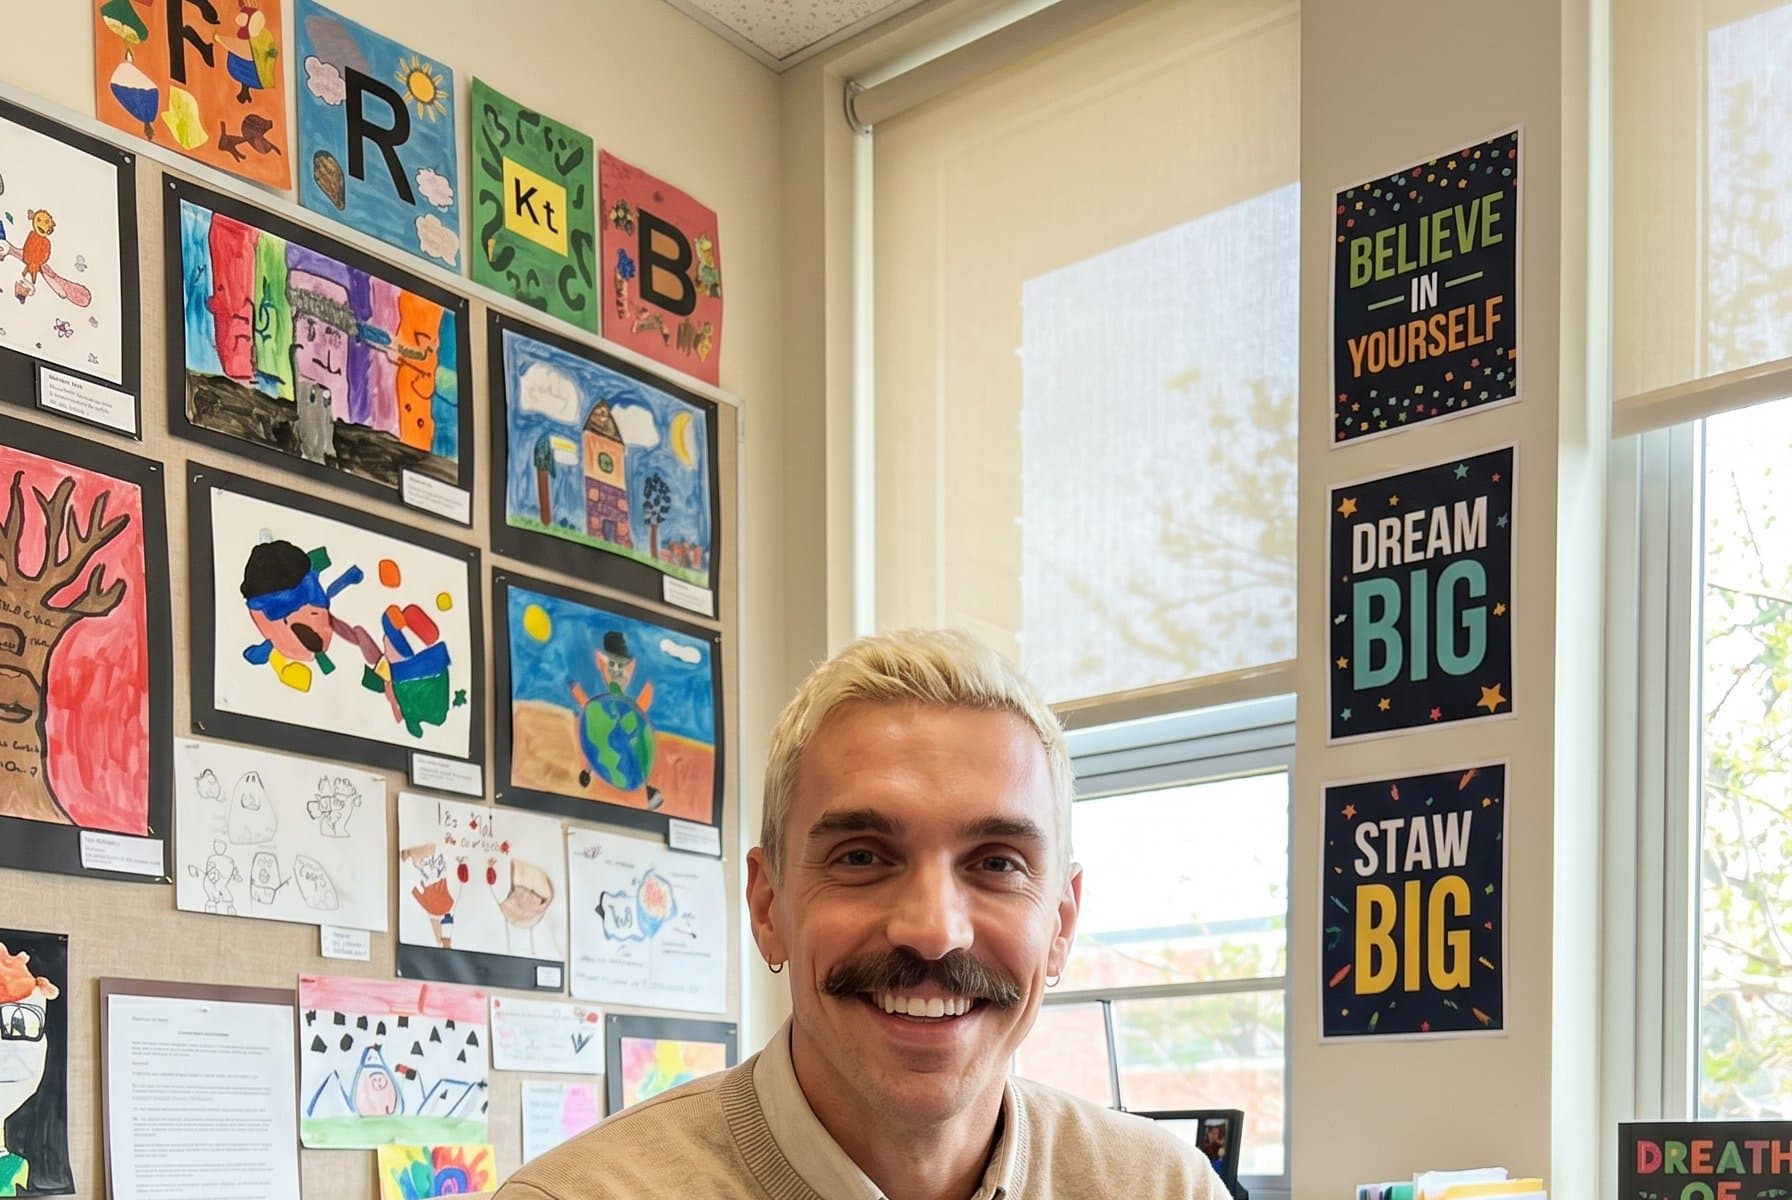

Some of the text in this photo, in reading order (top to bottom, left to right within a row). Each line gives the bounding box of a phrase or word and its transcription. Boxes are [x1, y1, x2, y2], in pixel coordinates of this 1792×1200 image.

[166, 0, 221, 85] F
[344, 66, 416, 206] R
[514, 177, 560, 237] Kt
[1349, 190, 1504, 289] BELIEVE
[637, 208, 698, 317] B
[1411, 271, 1438, 313] IN
[1348, 295, 1504, 378] YOURSELF
[1352, 496, 1488, 574] DREAM
[1353, 559, 1487, 691] BIG
[1354, 810, 1472, 877] STAW
[1355, 875, 1471, 995] BIG
